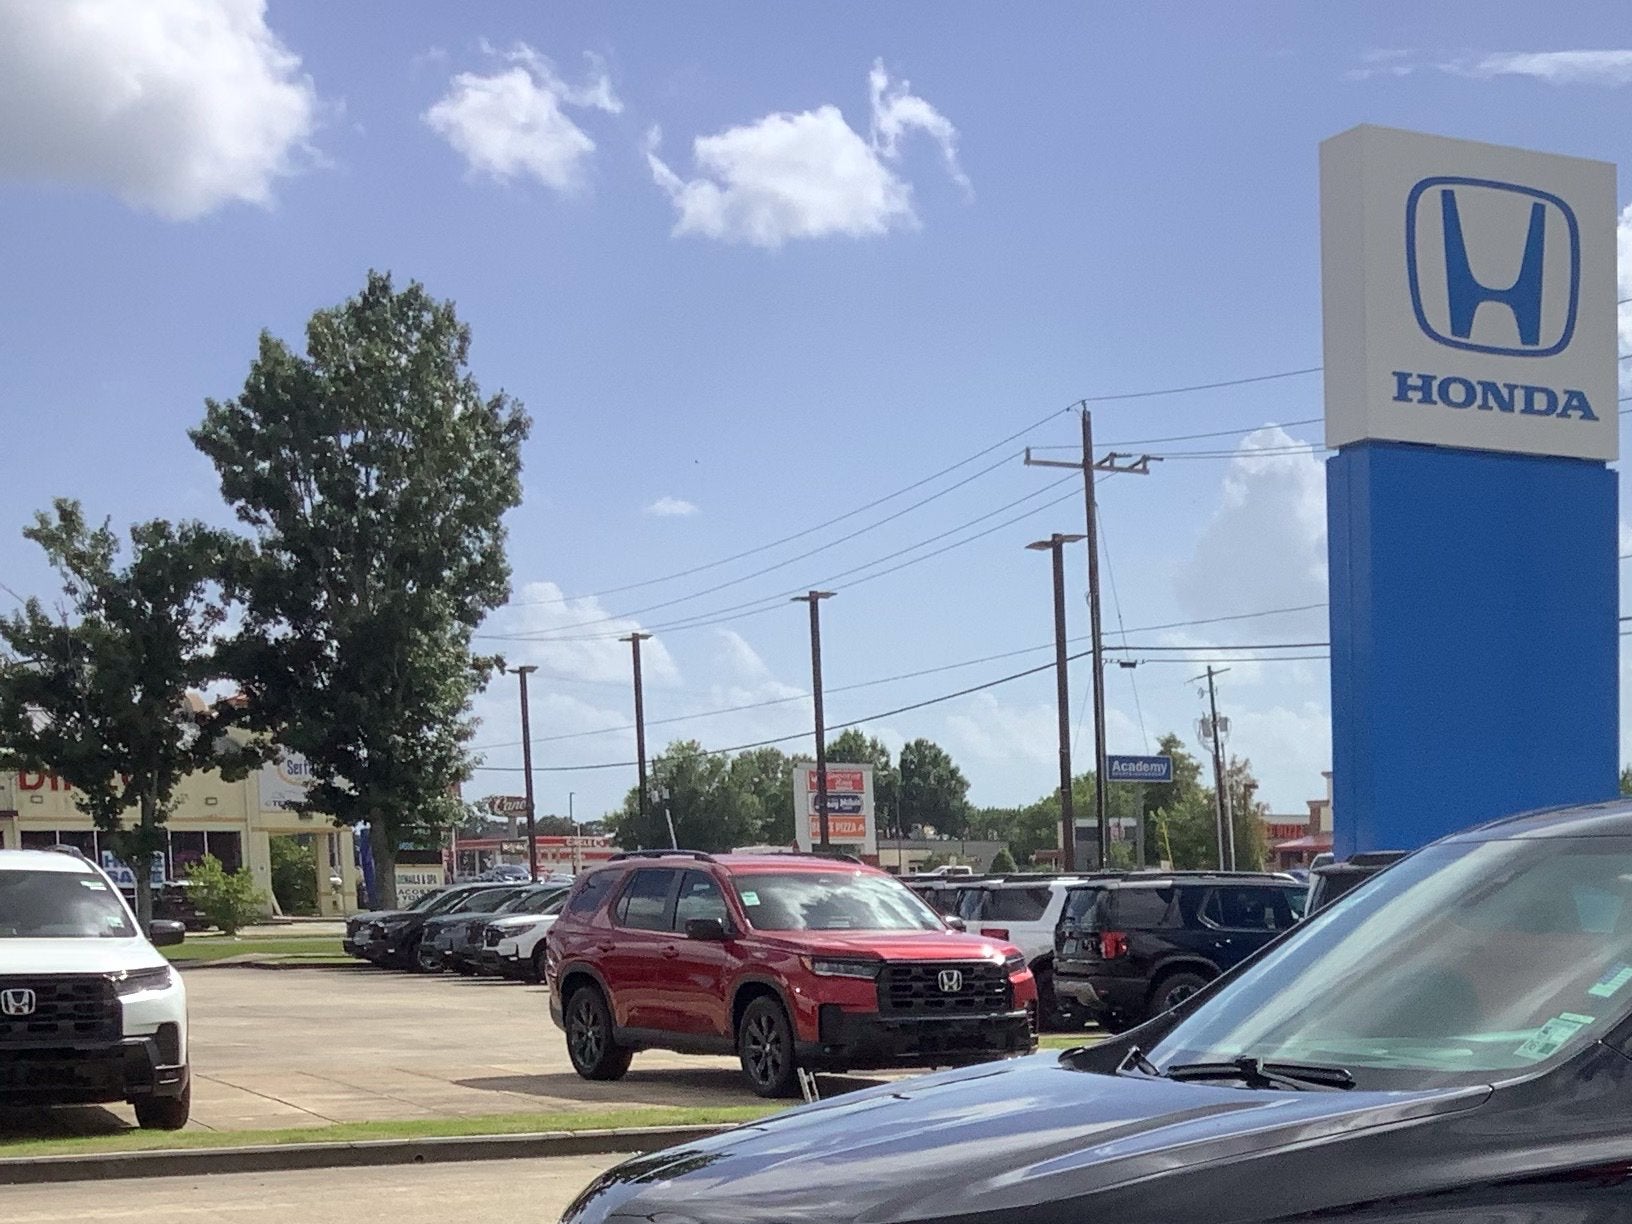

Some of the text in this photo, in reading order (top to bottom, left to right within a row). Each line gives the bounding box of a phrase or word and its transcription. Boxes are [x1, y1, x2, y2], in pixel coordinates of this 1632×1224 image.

[1391, 371, 1600, 422] HONDA
[1112, 760, 1168, 775] Academy
[494, 799, 528, 812] Cane
[107, 870, 163, 883] SAE
